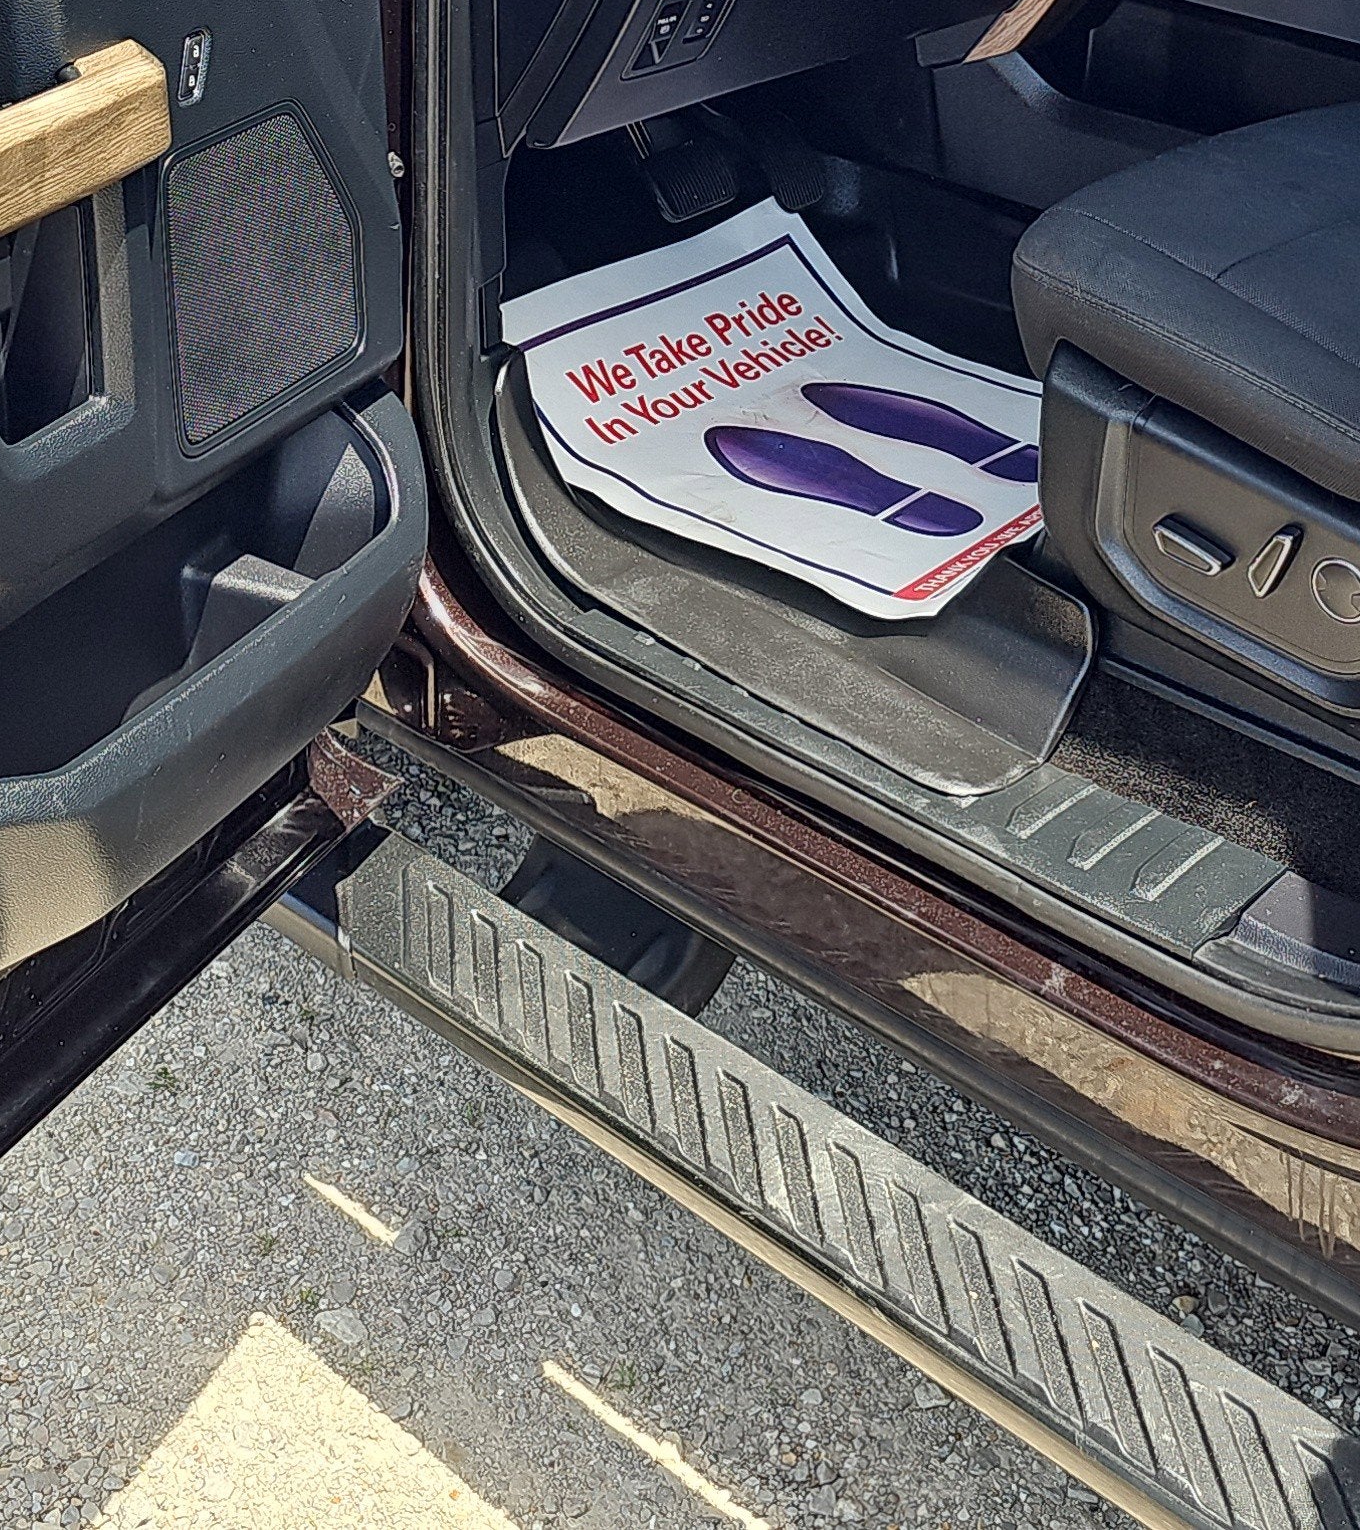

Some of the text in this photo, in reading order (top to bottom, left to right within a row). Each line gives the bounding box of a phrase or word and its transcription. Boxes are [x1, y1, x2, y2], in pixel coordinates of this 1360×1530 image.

[565, 291, 803, 405] We Take Pride
[584, 315, 843, 445] In Your Vehicle!
[914, 560, 968, 592] THANK
[994, 525, 1025, 541] WE
